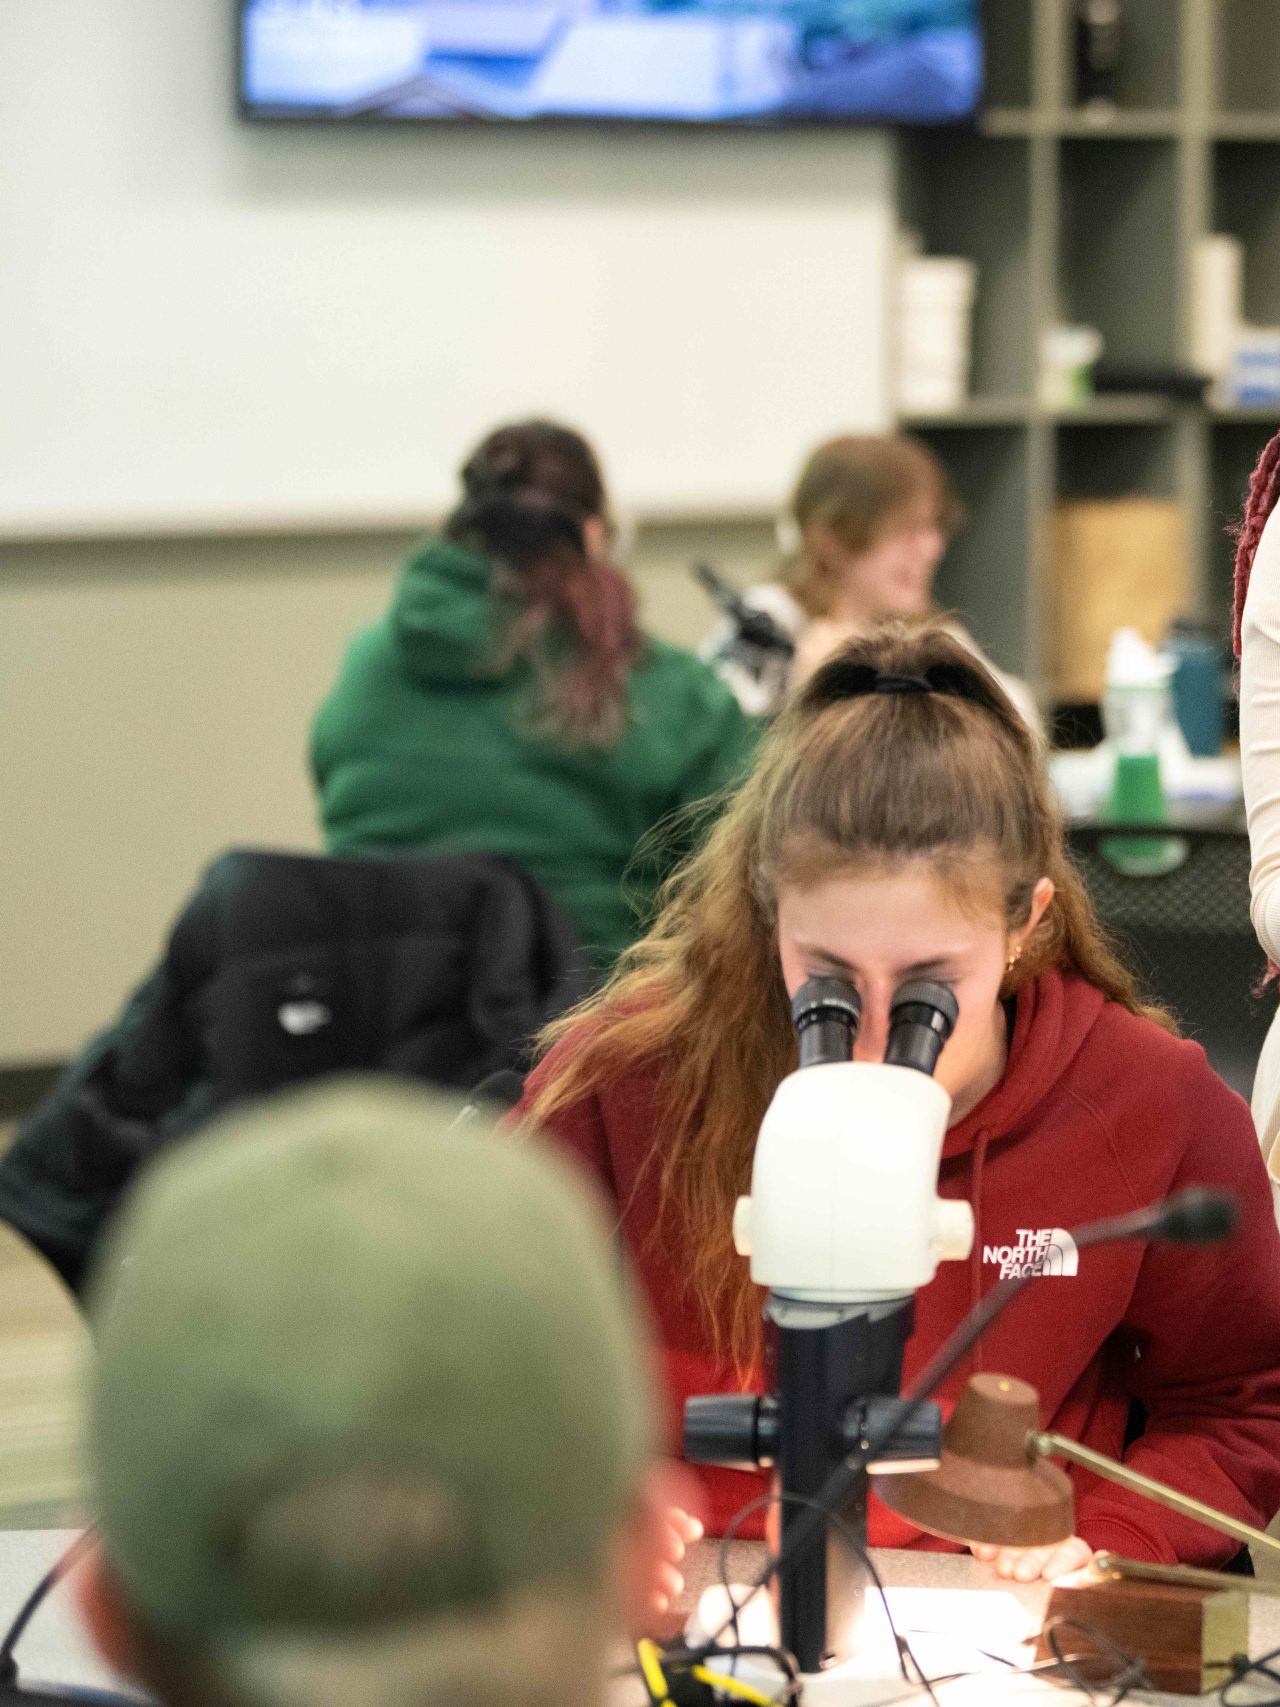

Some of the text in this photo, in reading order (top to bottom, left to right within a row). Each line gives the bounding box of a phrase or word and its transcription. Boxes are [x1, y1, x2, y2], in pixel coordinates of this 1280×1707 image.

[1015, 1229, 1051, 1247] THE
[983, 1245, 1048, 1264] NORTH
[999, 1263, 1042, 1280] FACE
